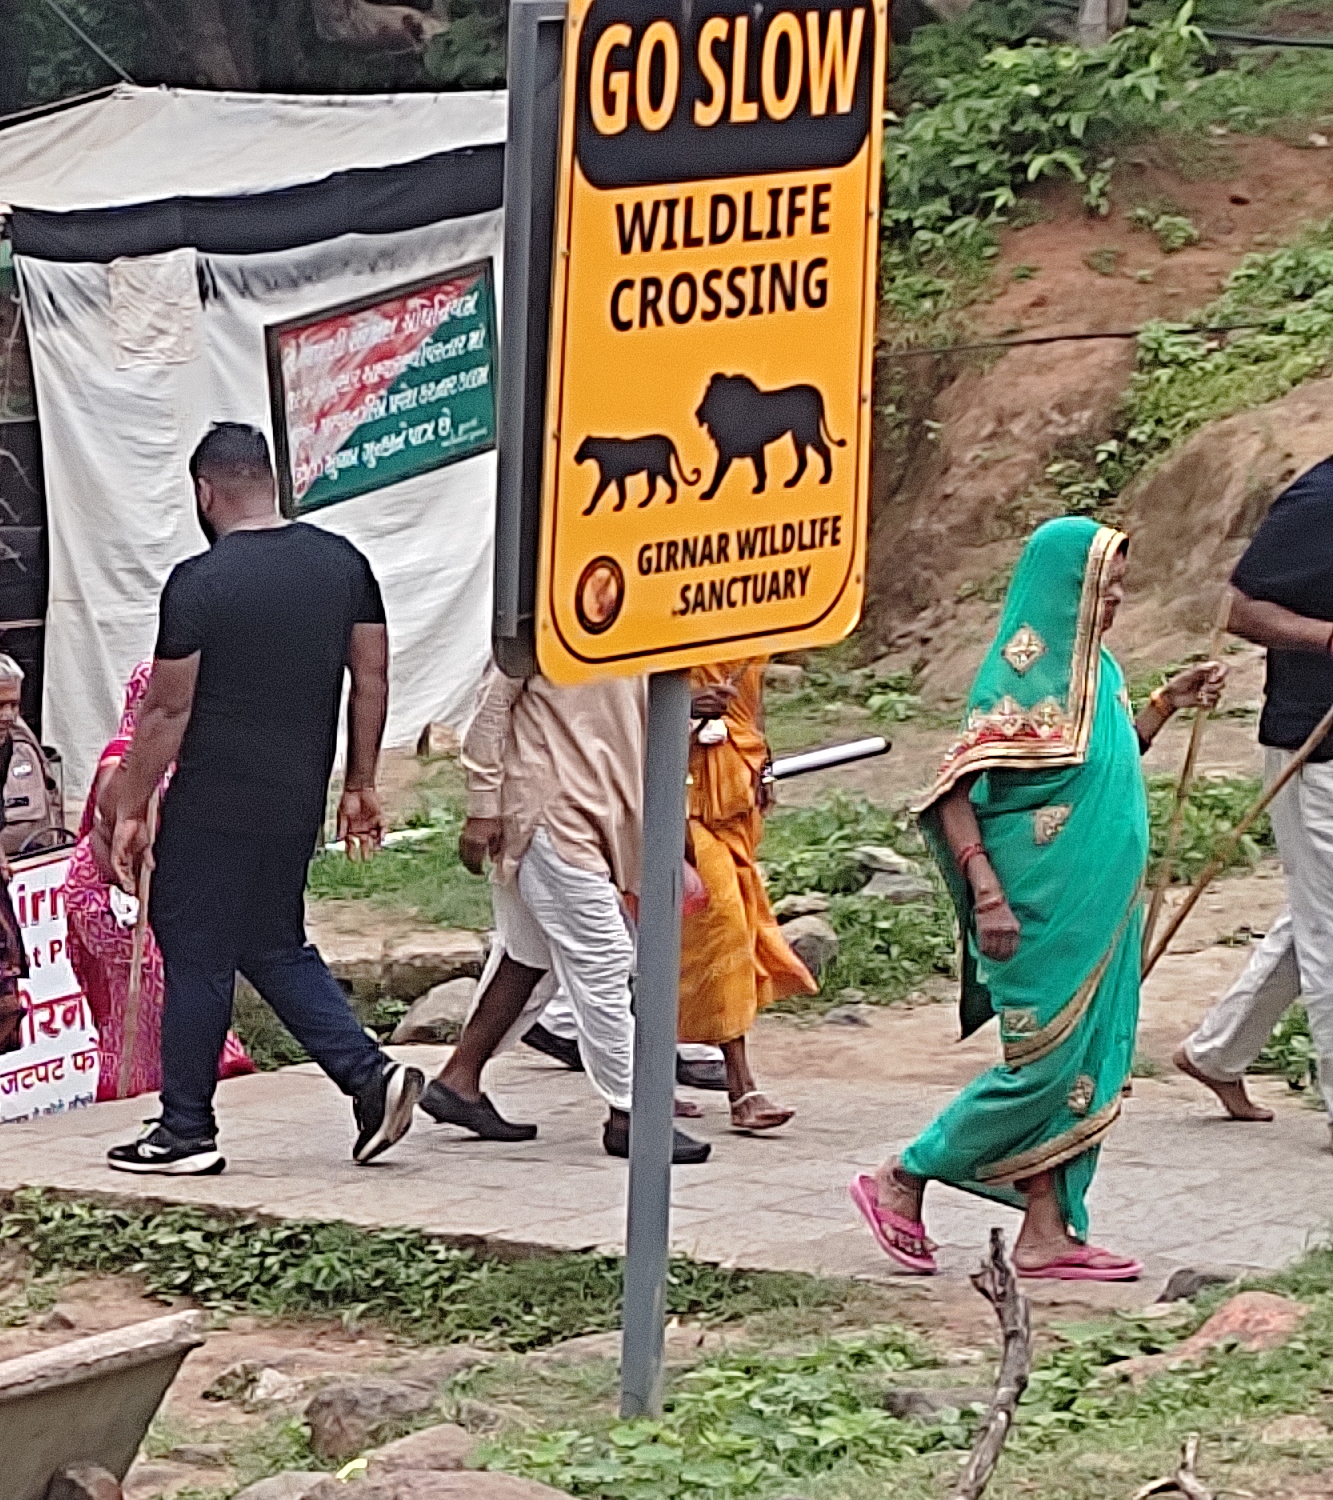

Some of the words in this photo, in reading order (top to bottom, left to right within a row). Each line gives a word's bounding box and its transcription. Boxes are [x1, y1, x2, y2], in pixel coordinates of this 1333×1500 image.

[590, 23, 679, 135] GO
[694, 8, 866, 127] SLOW
[615, 183, 831, 255] WILDLIFE
[610, 257, 828, 332] CROSSING
[638, 532, 730, 576] GIRNAR
[737, 515, 841, 560] WILDLIFE
